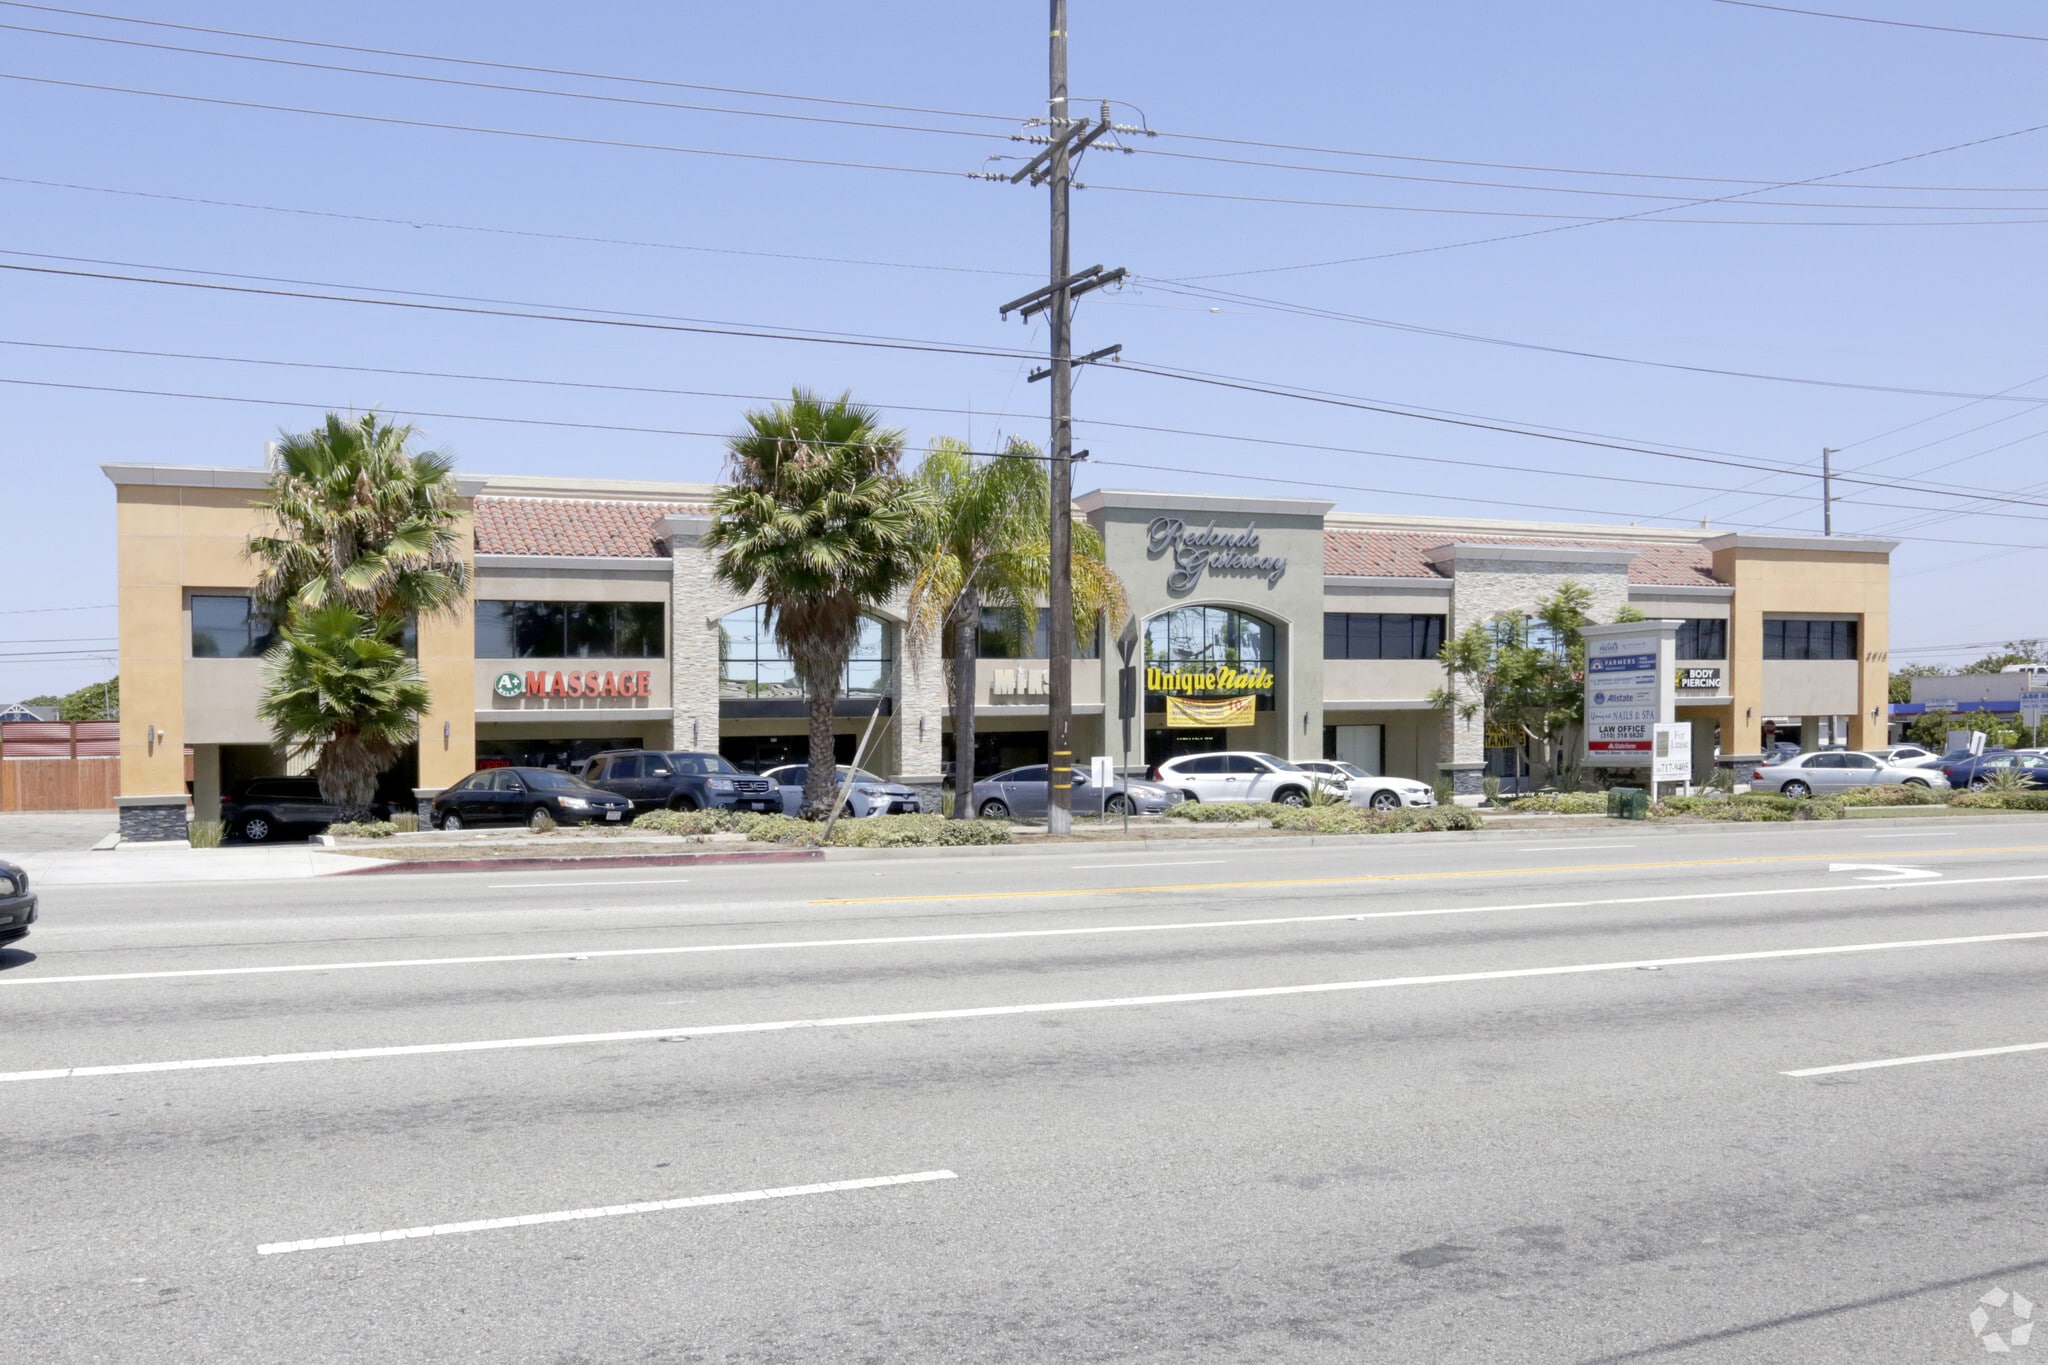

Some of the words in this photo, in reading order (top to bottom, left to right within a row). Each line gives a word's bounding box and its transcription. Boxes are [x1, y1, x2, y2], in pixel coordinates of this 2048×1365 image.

[1147, 517, 1261, 552] Redondo
[1168, 547, 1287, 590] Gateway
[1605, 658, 1635, 666] FARMERS
[1690, 670, 1713, 678] BODY
[526, 670, 651, 697] MASSAGE
[1147, 668, 1216, 694] Unique
[1682, 678, 1721, 687] PIERCING
[1607, 694, 1633, 702] Allstate
[1613, 710, 1633, 720] NAILS
[1642, 710, 1655, 719] SPA
[1599, 725, 1615, 733] LAW
[1674, 730, 1686, 740] For
[1671, 740, 1688, 750] Lease
